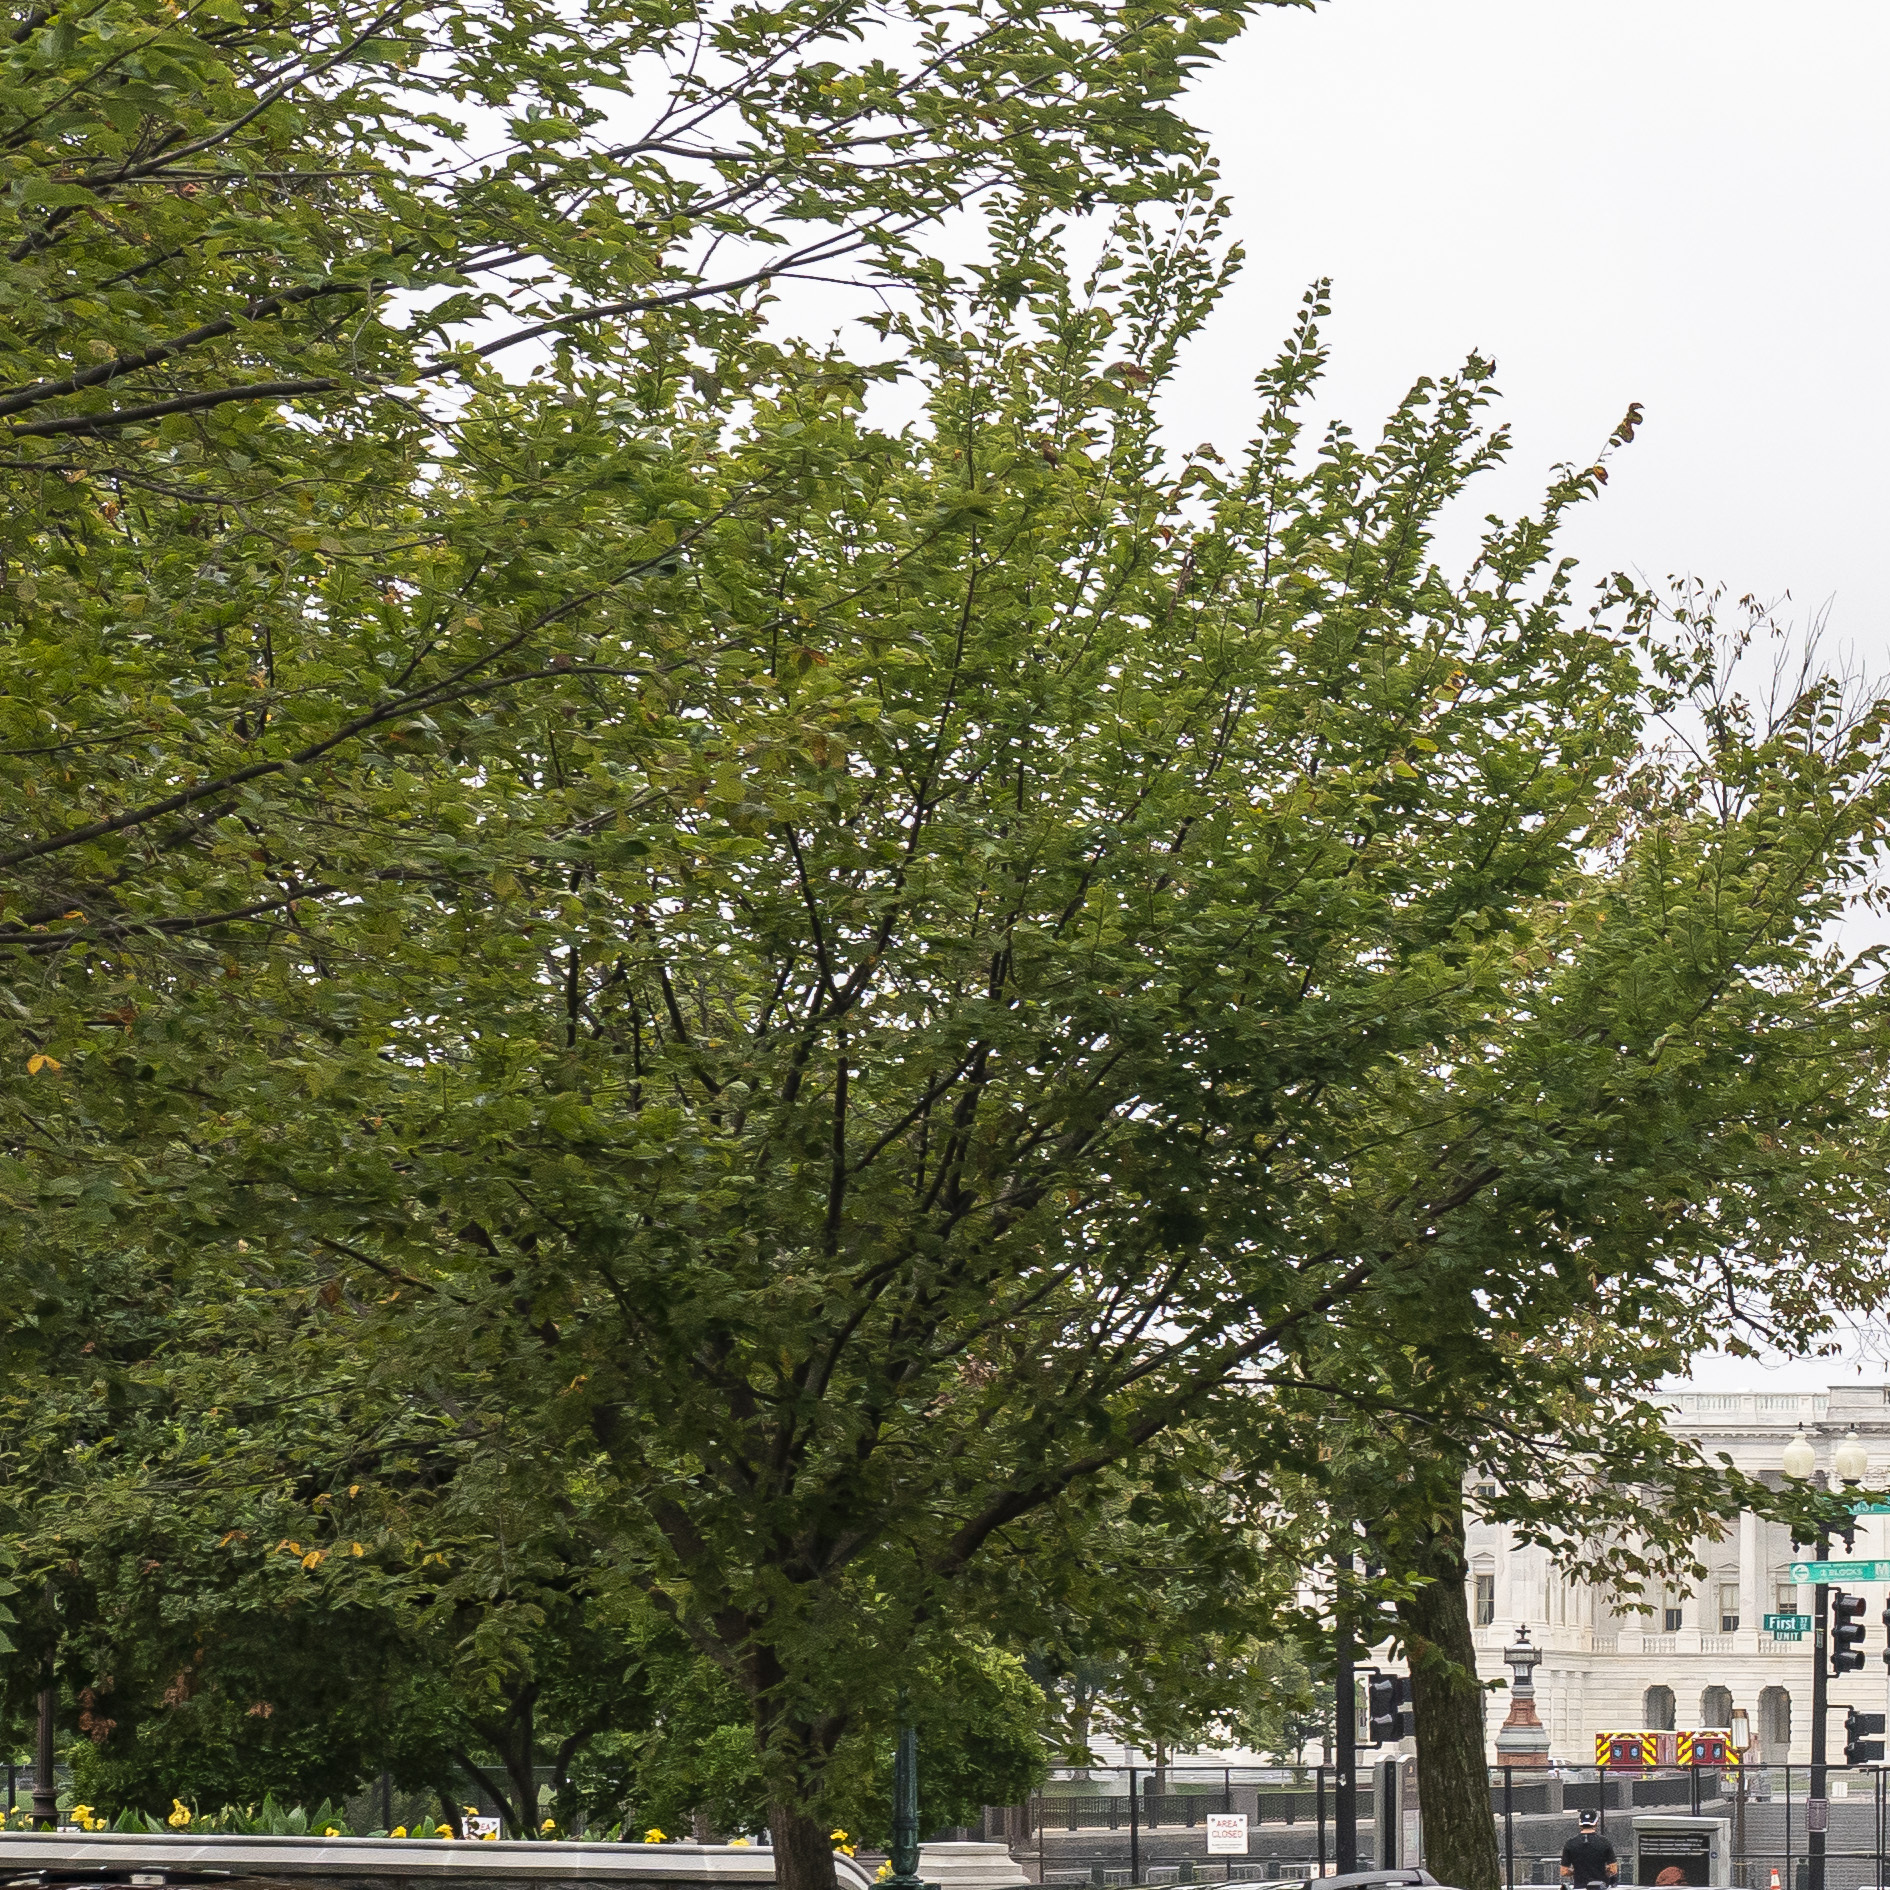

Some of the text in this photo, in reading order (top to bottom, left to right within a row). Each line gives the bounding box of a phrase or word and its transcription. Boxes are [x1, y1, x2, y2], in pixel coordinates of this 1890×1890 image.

[1769, 1616, 1796, 1630] First
[1776, 1631, 1799, 1640] UNIT
[1216, 1820, 1237, 1828] AREA
[1211, 1830, 1243, 1839] CLOSED
